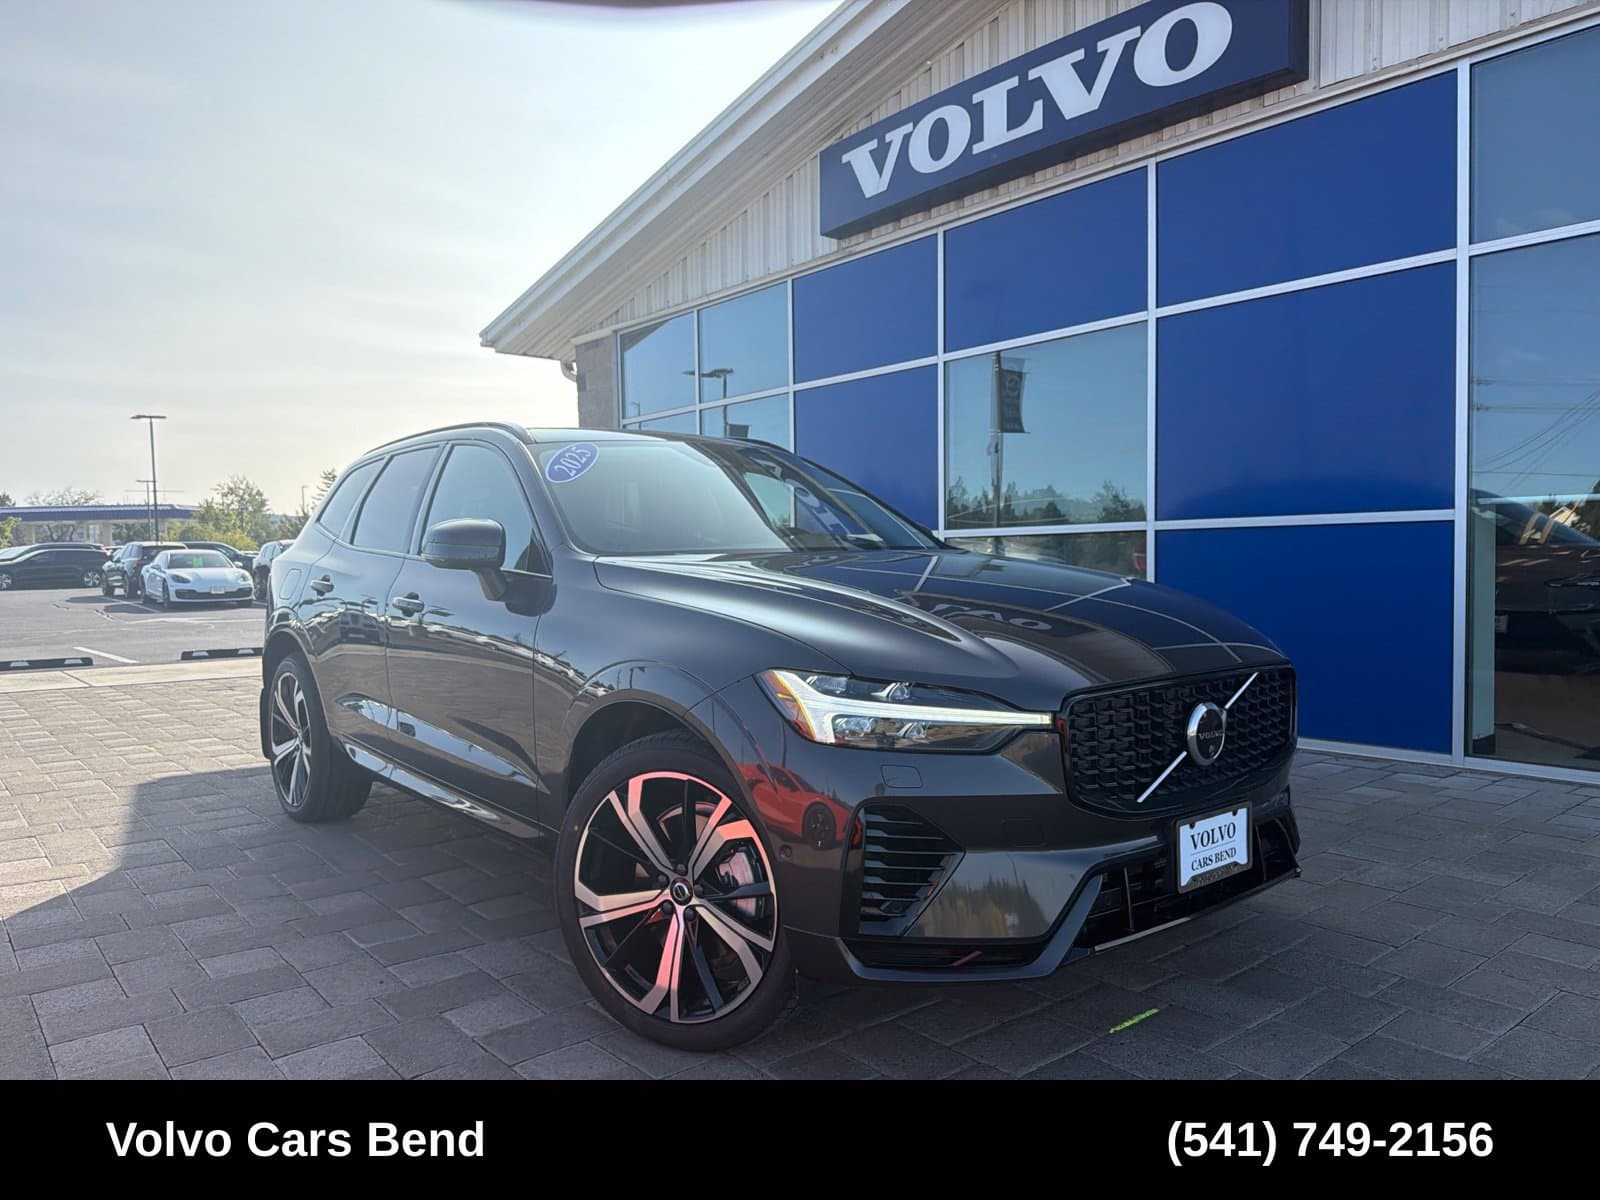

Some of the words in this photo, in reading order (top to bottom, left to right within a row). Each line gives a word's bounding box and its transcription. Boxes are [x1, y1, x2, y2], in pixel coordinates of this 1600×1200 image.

[841, 1, 1233, 198] VOLVO
[554, 446, 591, 477] 2025
[1190, 822, 1236, 850] VOLVO
[1191, 854, 1213, 871] CARS
[1214, 847, 1237, 864] BEND
